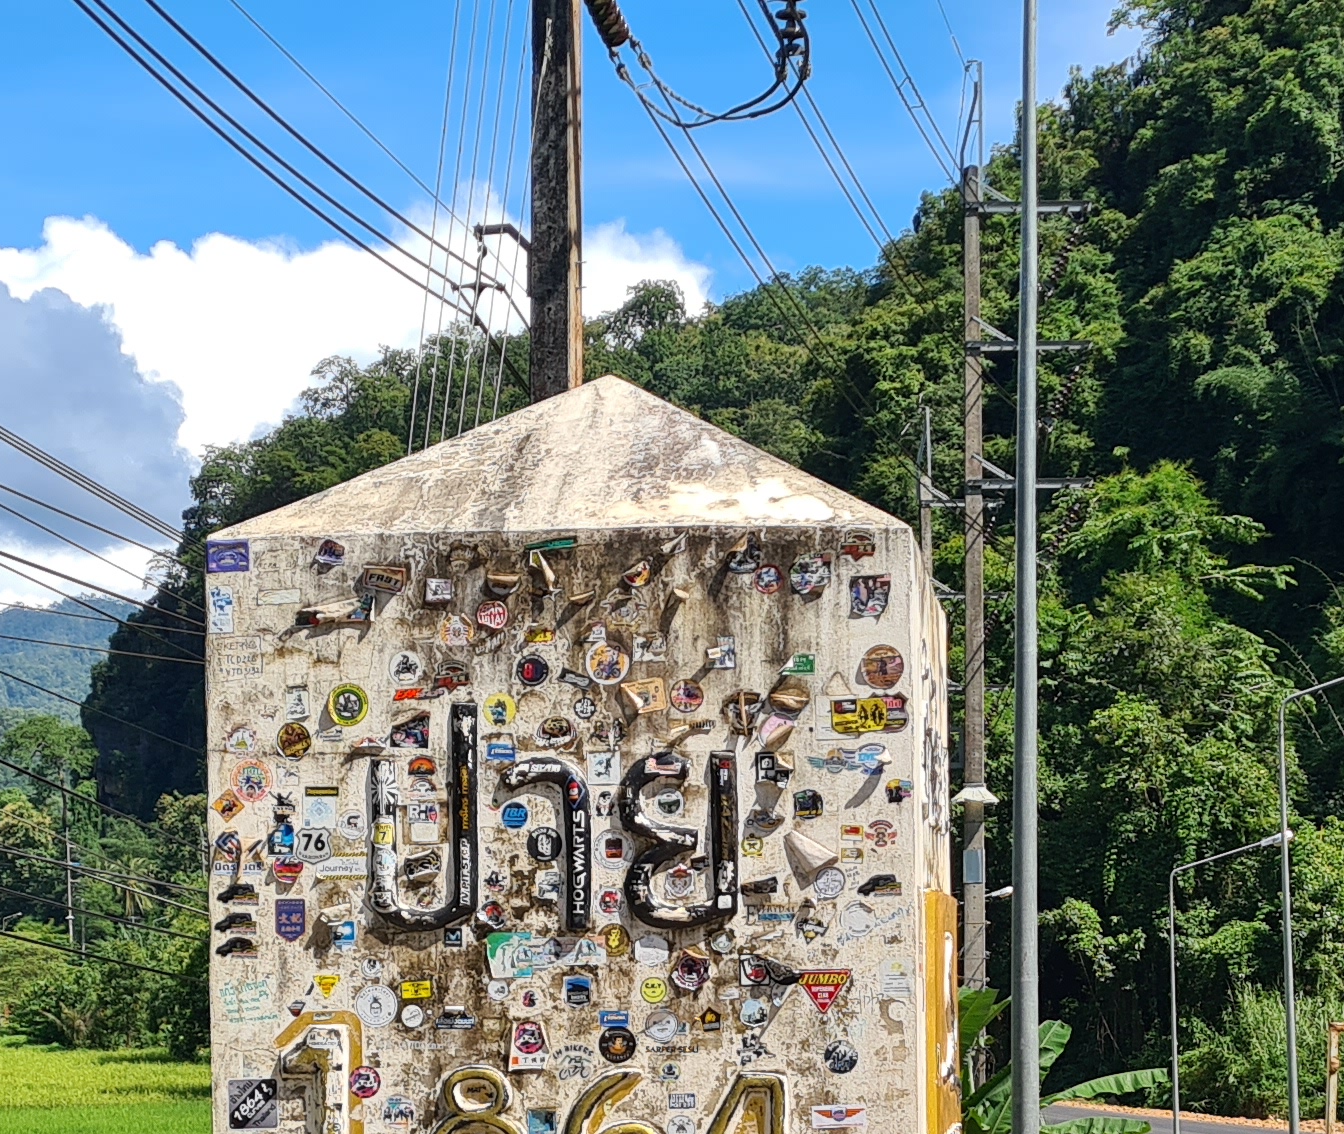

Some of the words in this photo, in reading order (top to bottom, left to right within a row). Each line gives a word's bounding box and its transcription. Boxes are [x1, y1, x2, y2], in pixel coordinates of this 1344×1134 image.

[368, 702, 740, 934] ปาย
[302, 832, 326, 851] 76
[378, 831, 387, 841] 7
[572, 810, 586, 915] HOGWARTS
[798, 973, 847, 985] JUMBO
[233, 1088, 264, 1121] 1864
